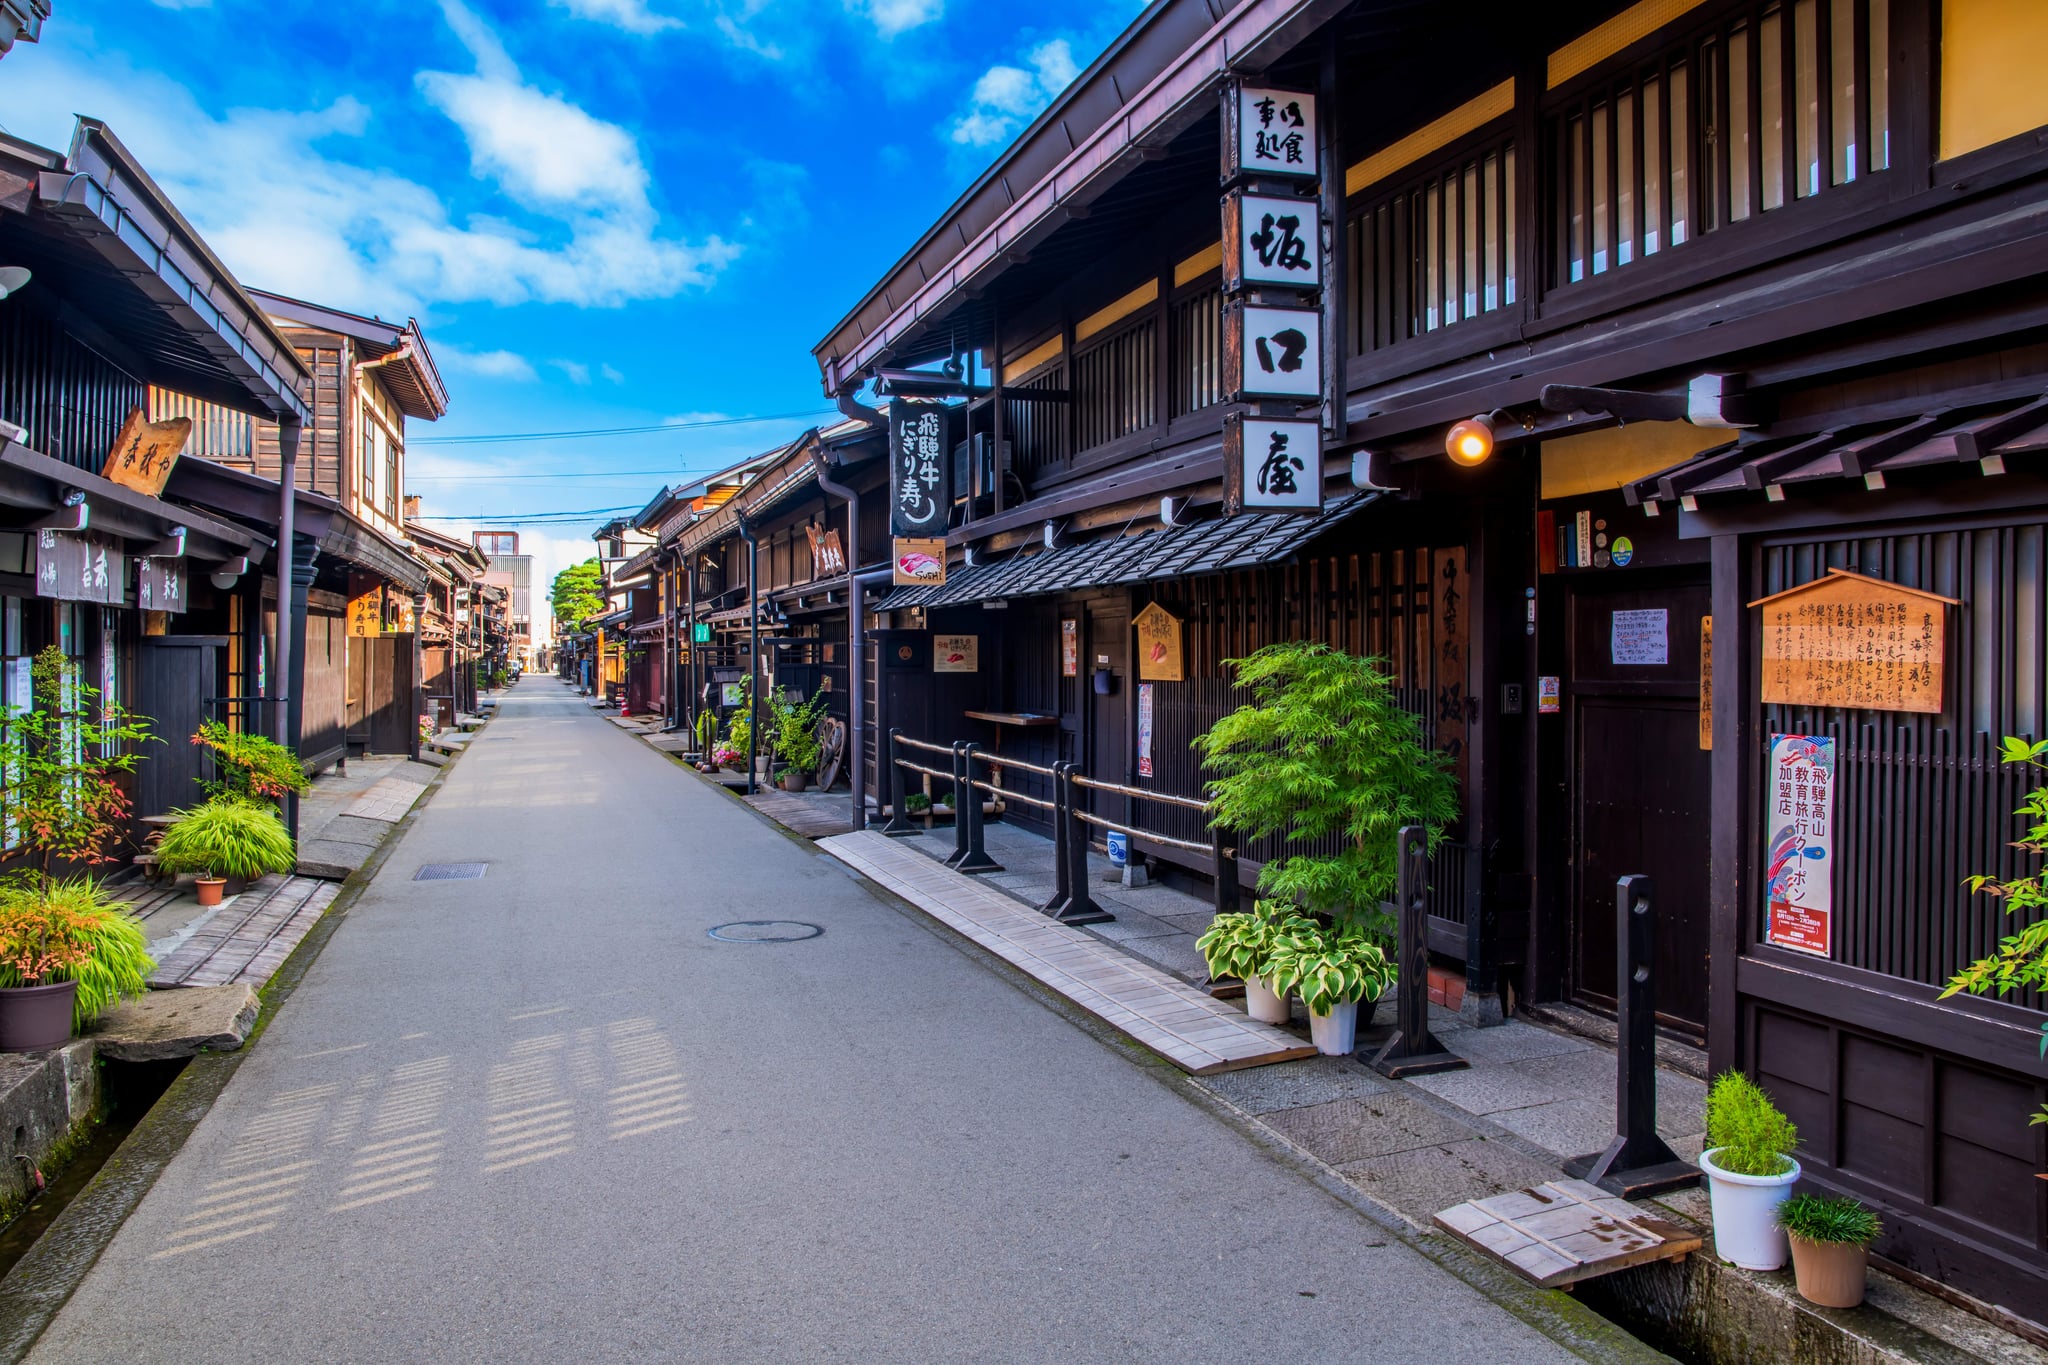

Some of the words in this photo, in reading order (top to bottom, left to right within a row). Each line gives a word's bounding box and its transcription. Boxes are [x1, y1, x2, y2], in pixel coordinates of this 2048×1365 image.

[917, 412, 940, 491] 飛騨牛
[1778, 764, 1793, 816] 加盟店
[1812, 767, 1827, 838] 飛騨高山
[1793, 766, 1810, 902] 教育旅行クーポン
